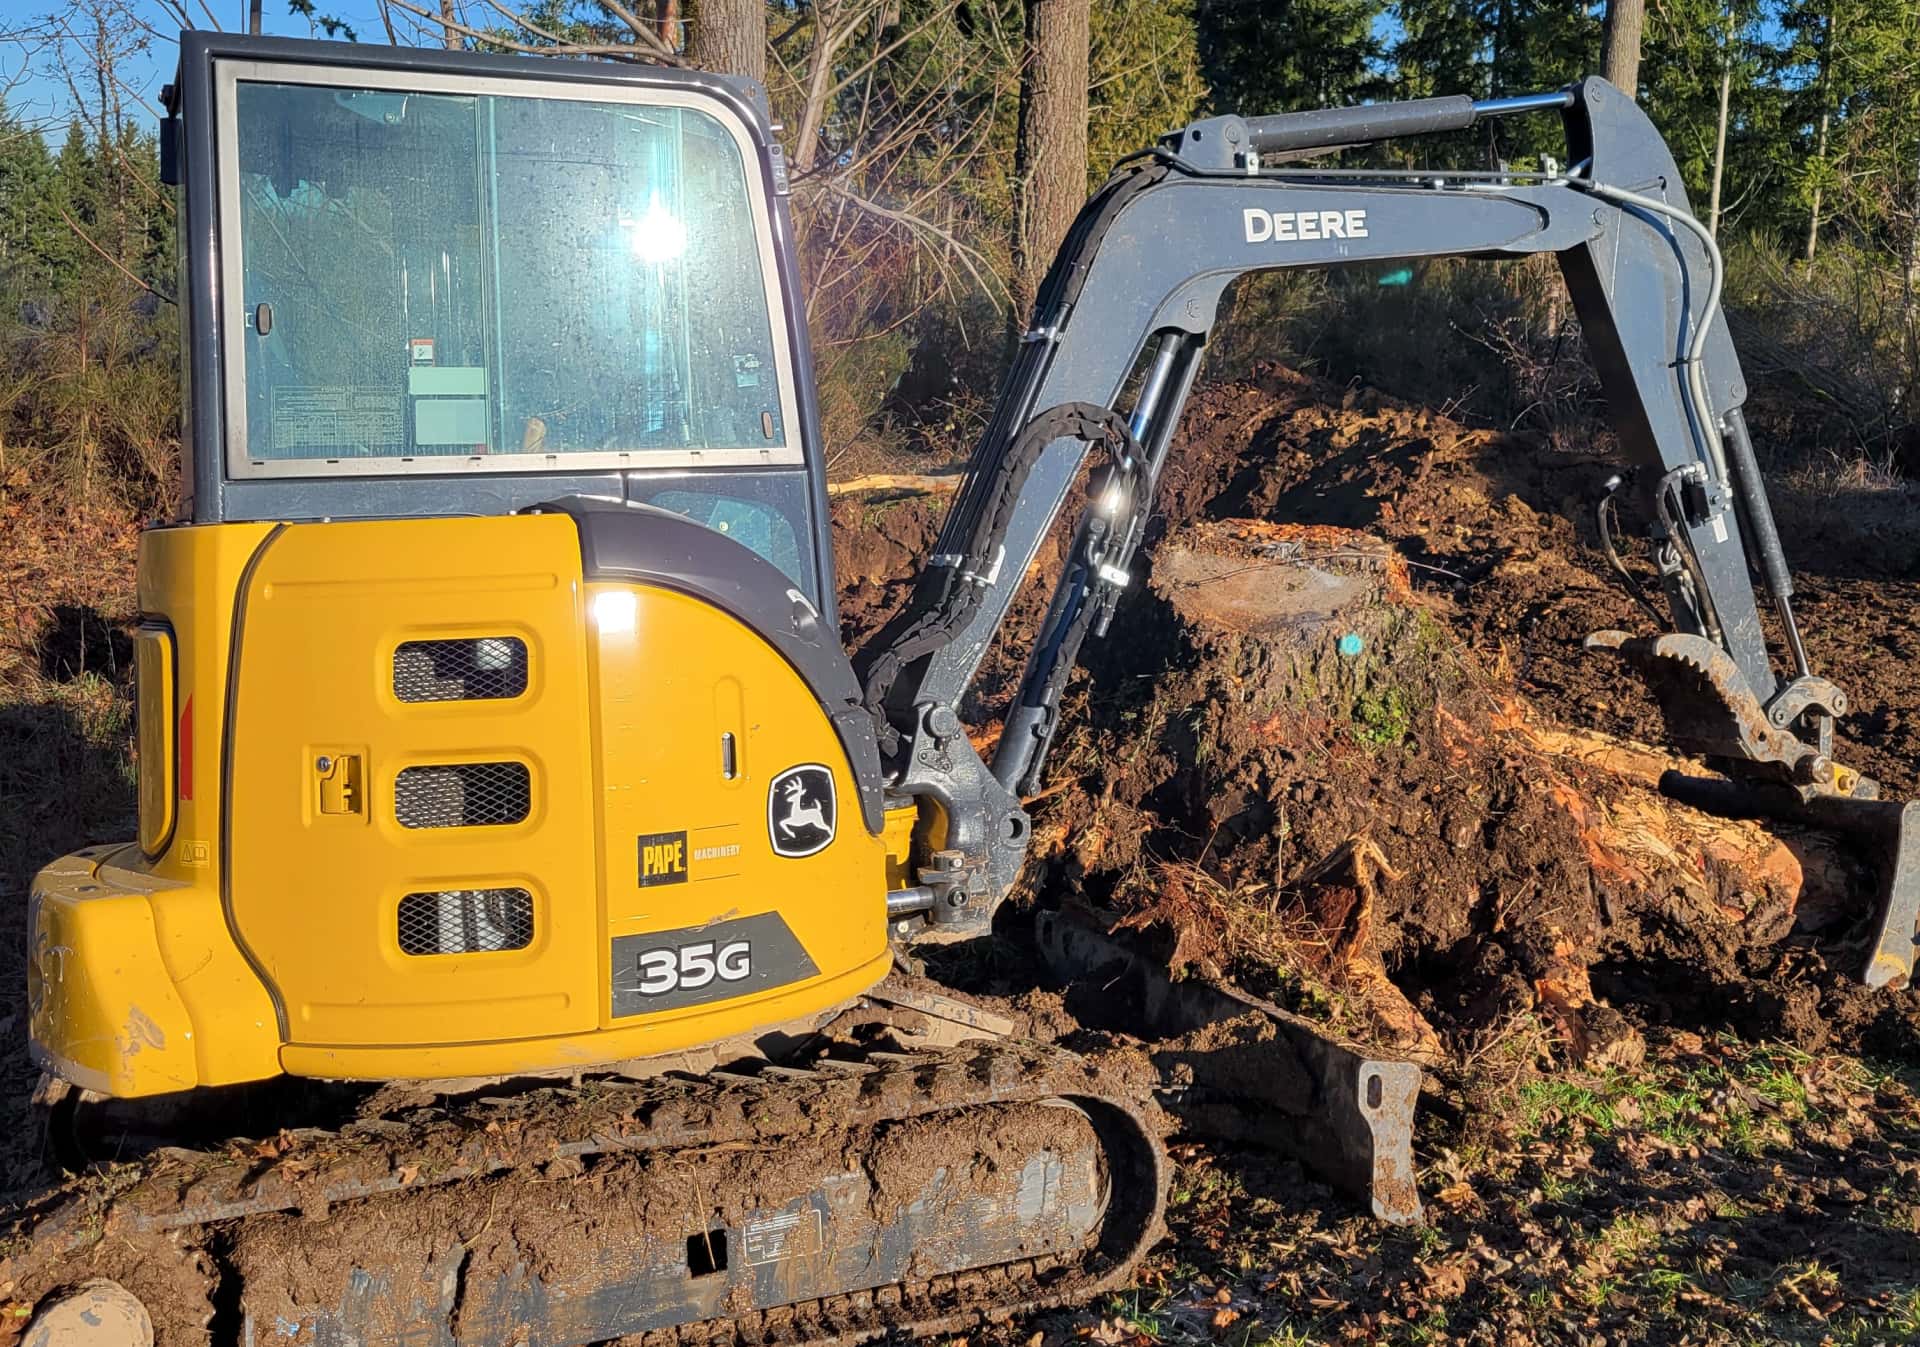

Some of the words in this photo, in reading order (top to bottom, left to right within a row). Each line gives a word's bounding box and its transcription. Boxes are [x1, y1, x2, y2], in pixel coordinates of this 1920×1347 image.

[1243, 208, 1369, 243] DEERE
[694, 845, 740, 861] MACHINERY
[639, 941, 751, 995] 35G
